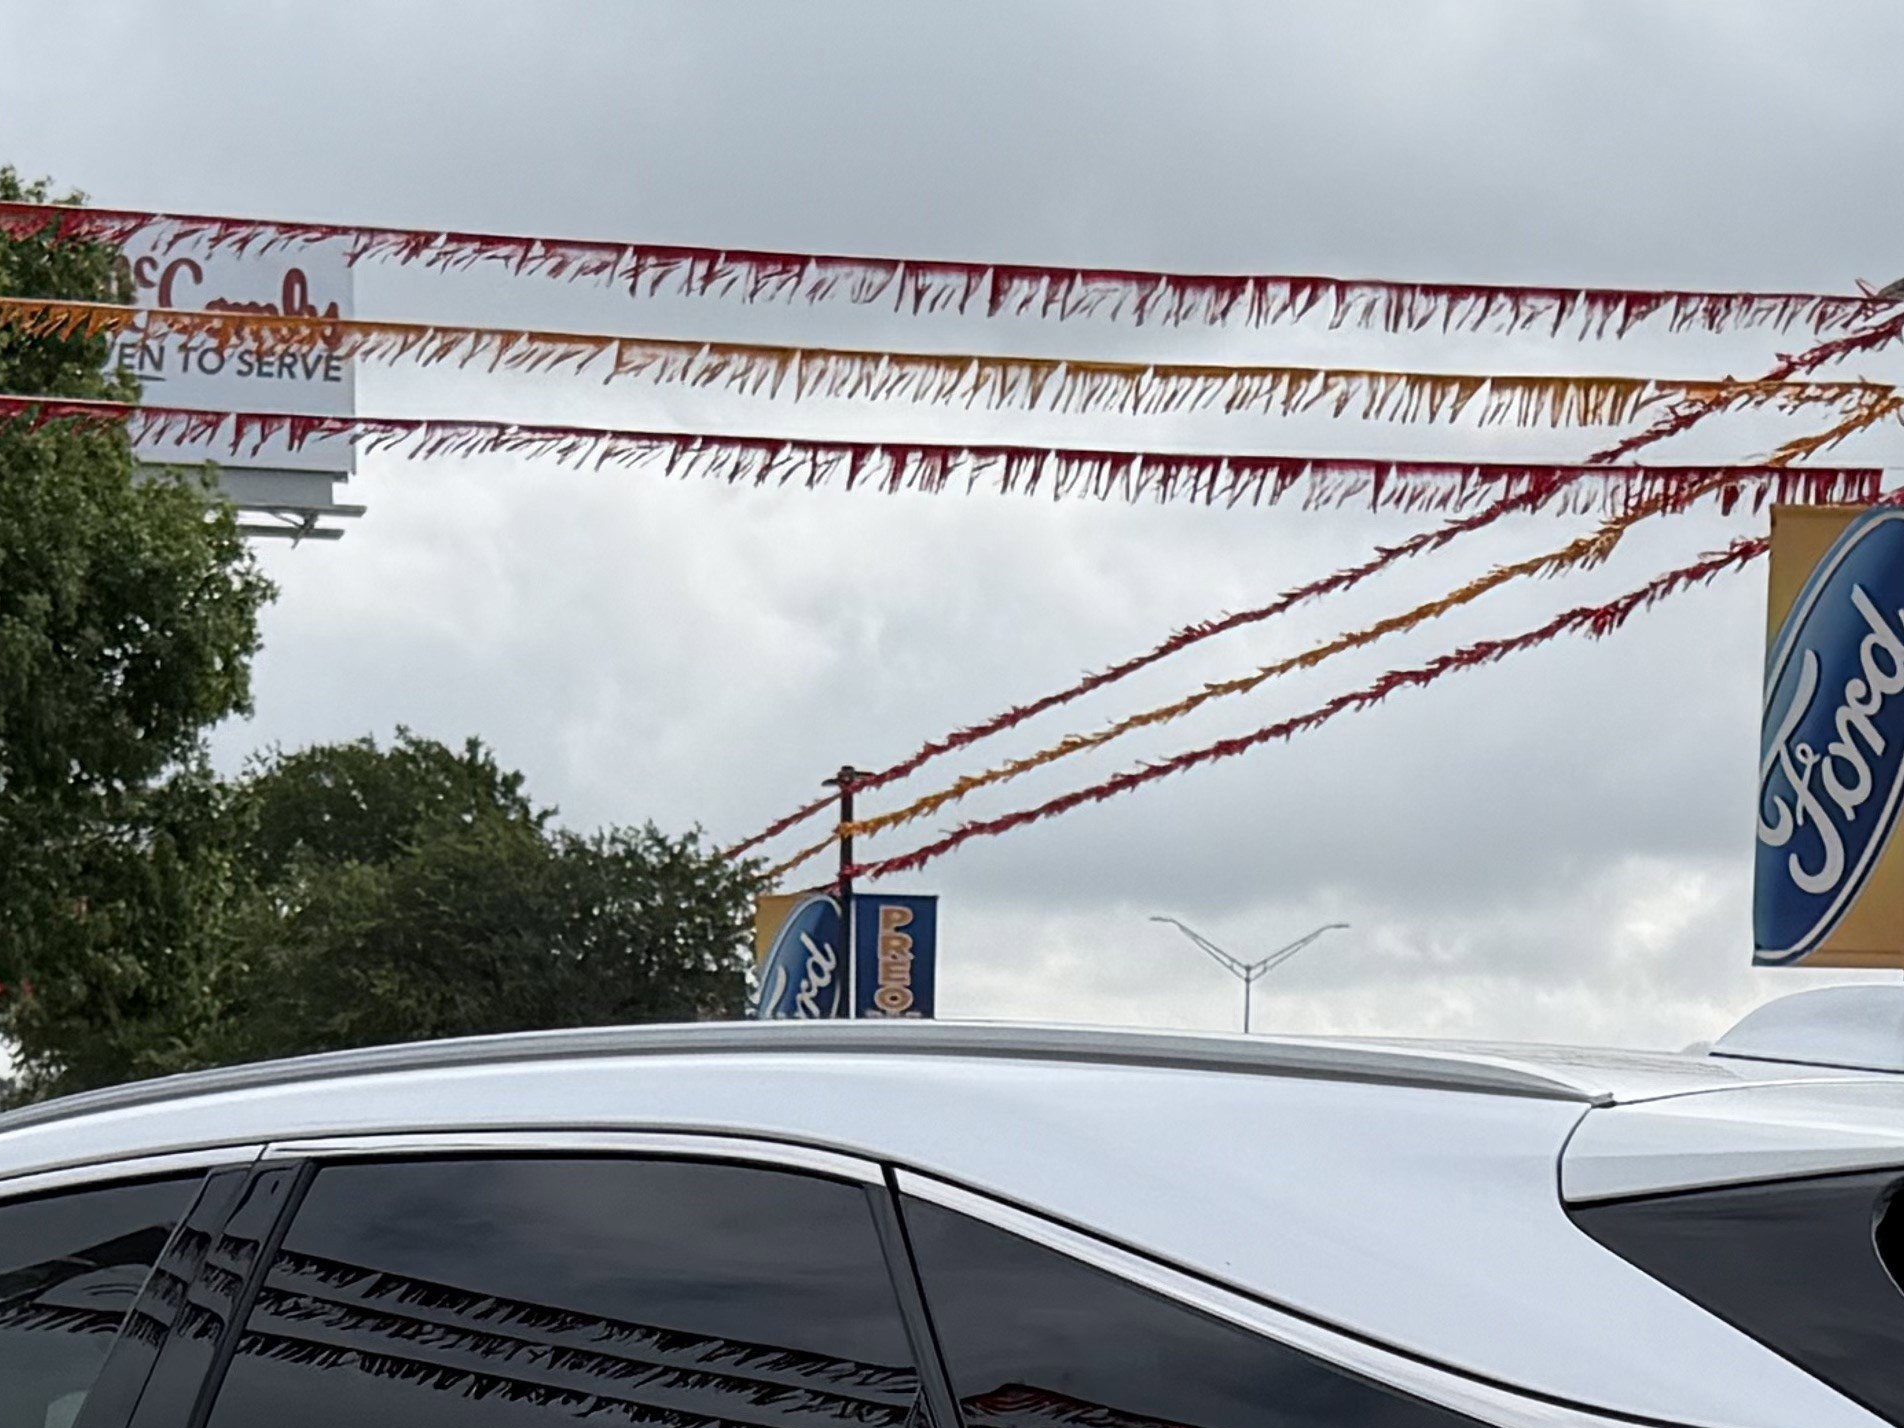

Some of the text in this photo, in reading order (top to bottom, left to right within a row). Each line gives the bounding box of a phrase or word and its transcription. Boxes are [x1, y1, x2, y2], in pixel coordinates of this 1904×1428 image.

[179, 344, 226, 375] TO
[236, 349, 343, 382] SERVE
[865, 904, 923, 1017] PREO
